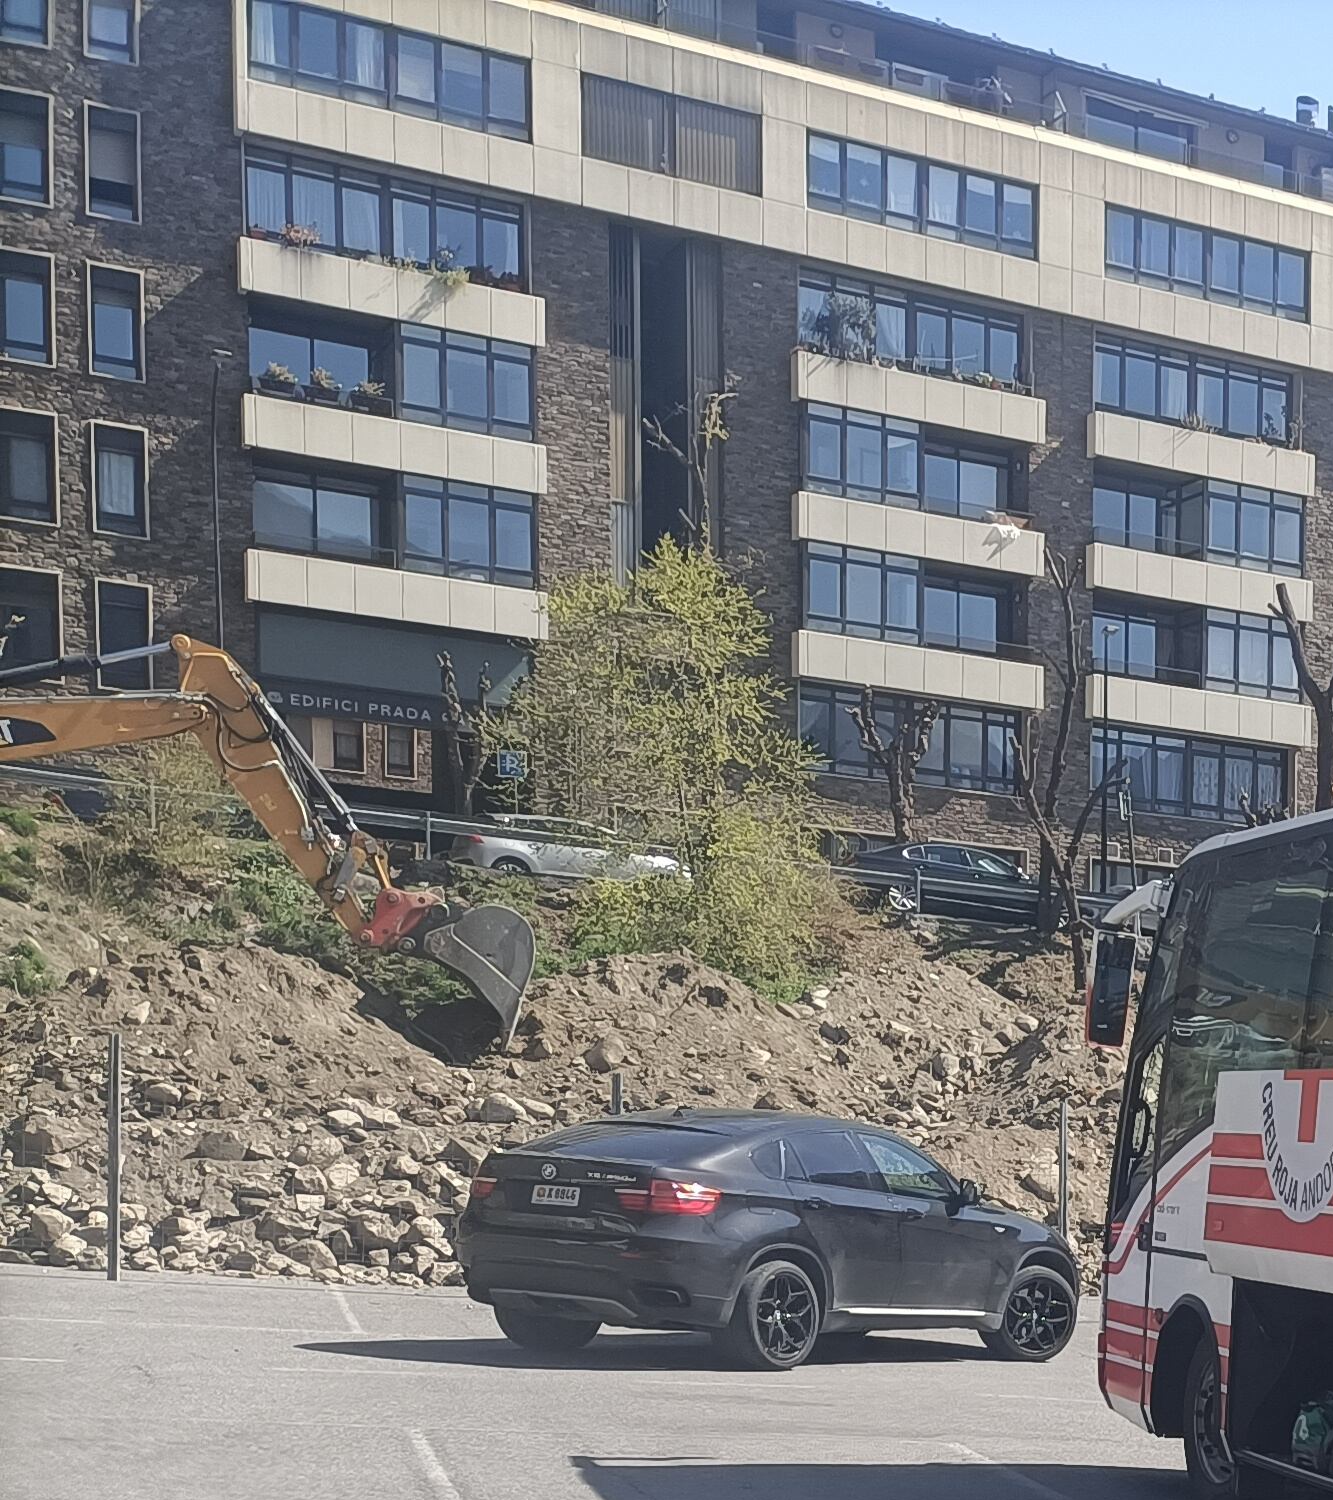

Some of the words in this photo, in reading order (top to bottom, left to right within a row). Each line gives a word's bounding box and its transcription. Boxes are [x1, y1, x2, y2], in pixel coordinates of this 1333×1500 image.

[290, 693, 359, 713] EDIFICI
[368, 703, 432, 721] PRADA
[1262, 1081, 1278, 1162] CREU
[1272, 1153, 1299, 1211] ROJA
